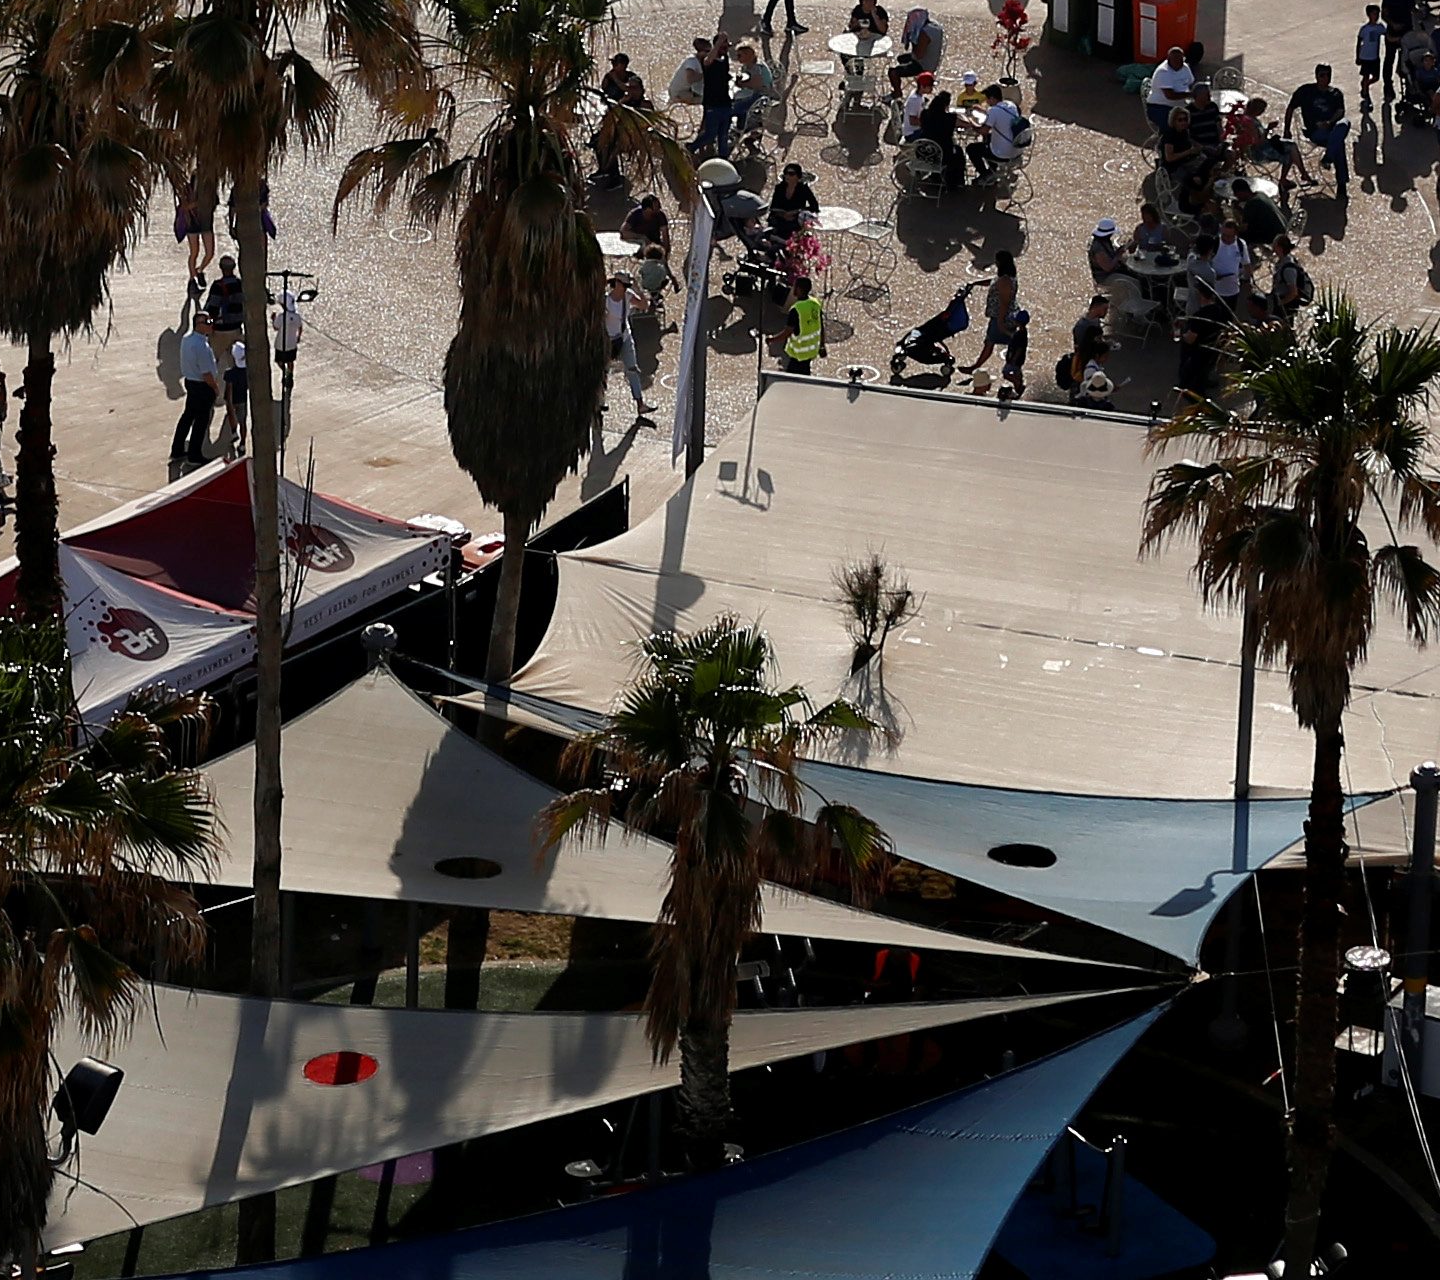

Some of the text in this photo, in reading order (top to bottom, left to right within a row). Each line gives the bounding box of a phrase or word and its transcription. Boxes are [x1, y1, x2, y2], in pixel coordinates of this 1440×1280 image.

[362, 584, 378, 598] FOR
[381, 565, 416, 589] PAYMENT
[176, 652, 235, 689] FOR PAYMENT
